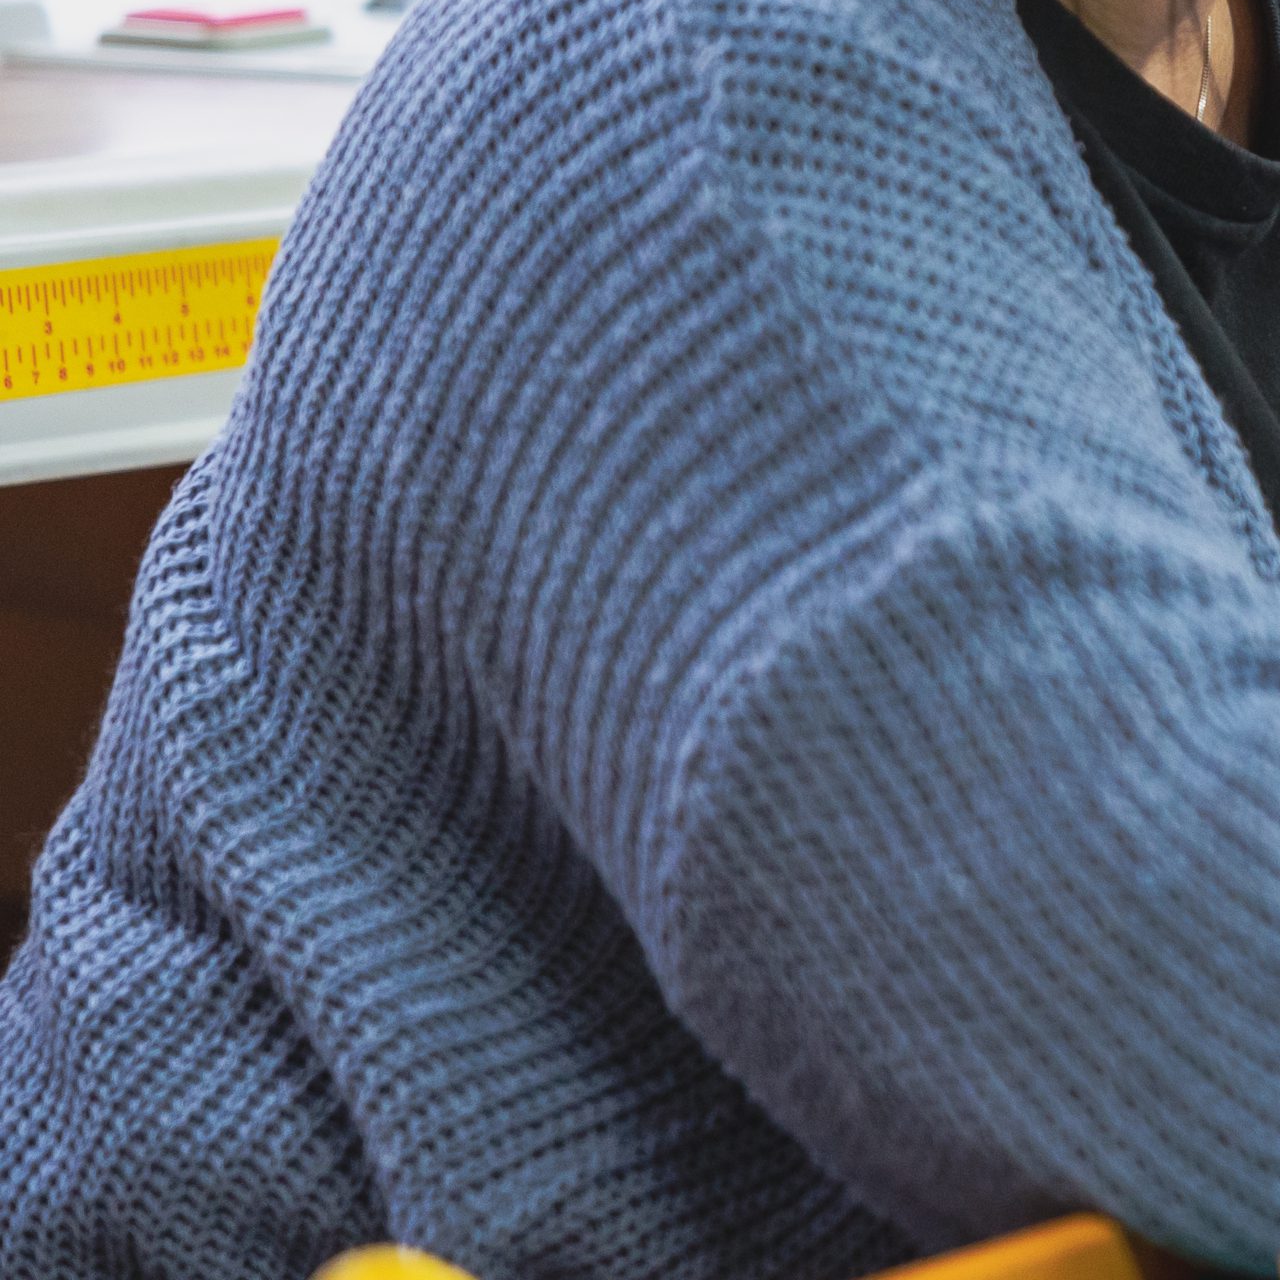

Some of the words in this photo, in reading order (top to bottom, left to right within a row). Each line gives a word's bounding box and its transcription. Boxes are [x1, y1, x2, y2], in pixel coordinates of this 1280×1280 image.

[44, 320, 52, 335] 3
[113, 312, 122, 324] 4
[4, 376, 13, 389] 6
[32, 371, 40, 385] 7
[86, 363, 95, 376] 9
[109, 358, 126, 373] 10
[139, 355, 153, 367] 11
[163, 351, 180, 365] 12
[189, 347, 205, 362] 13
[214, 345, 230, 358] 14
